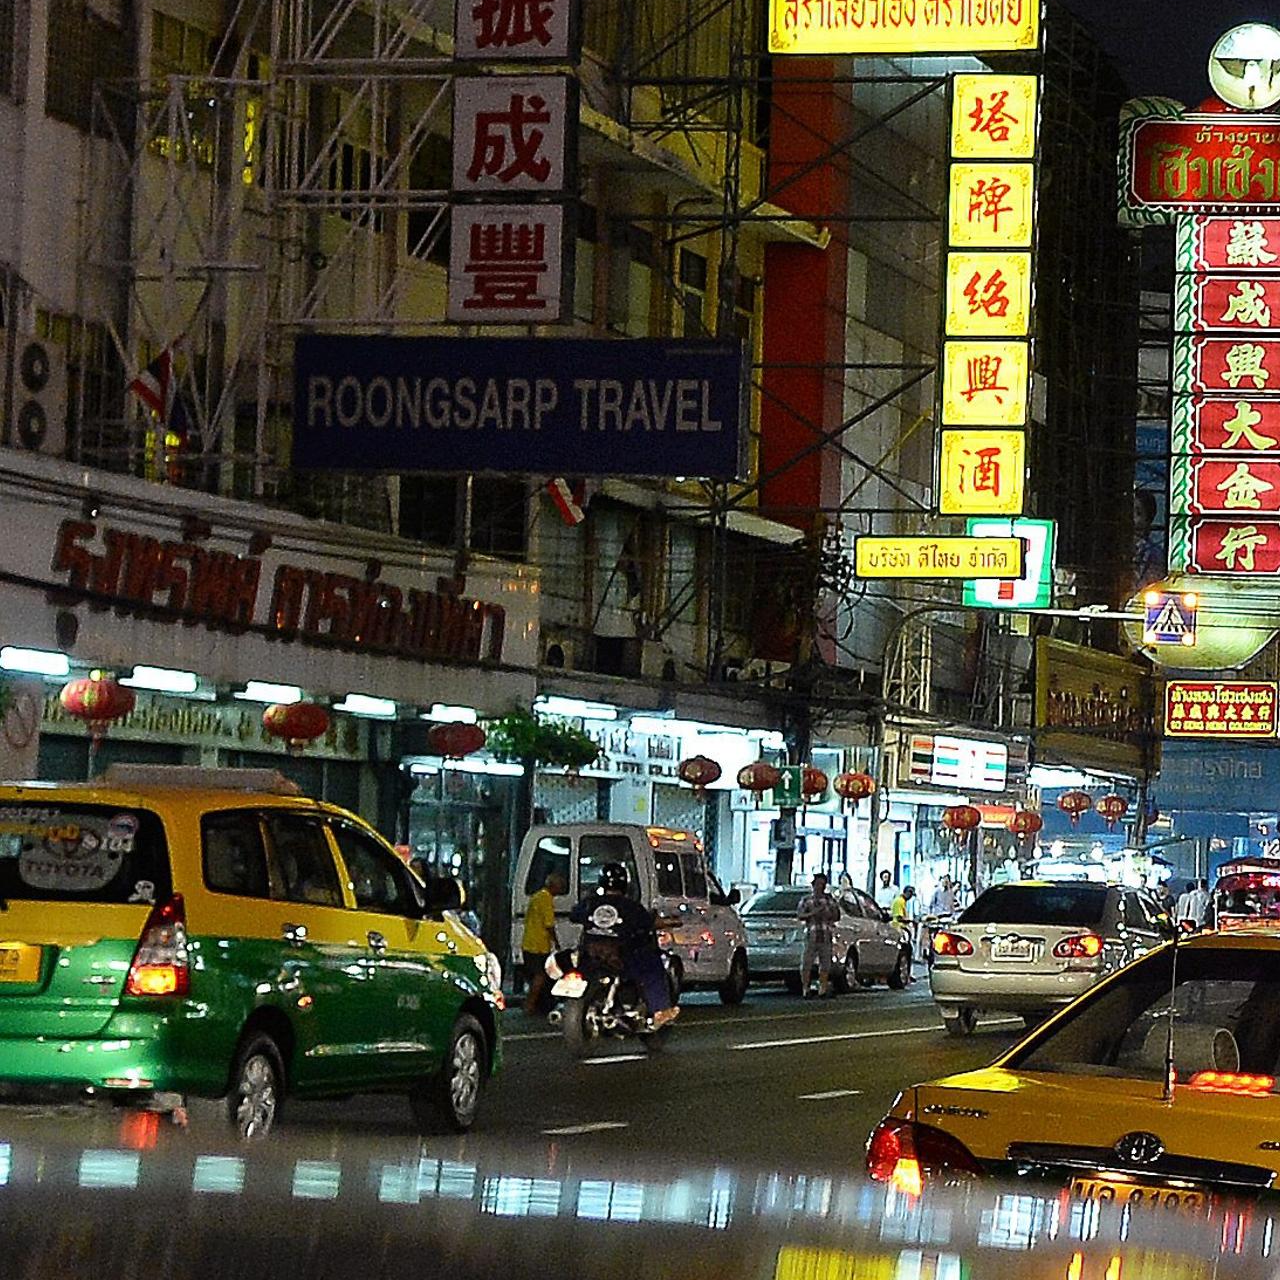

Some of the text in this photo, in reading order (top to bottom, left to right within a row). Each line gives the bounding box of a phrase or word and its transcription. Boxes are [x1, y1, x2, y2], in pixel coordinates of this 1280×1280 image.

[306, 374, 724, 433] ROONGSARP TRAVEL
[958, 92, 1019, 500] 塔牌紹興酒
[1215, 222, 1278, 572] 蘇成興大金行
